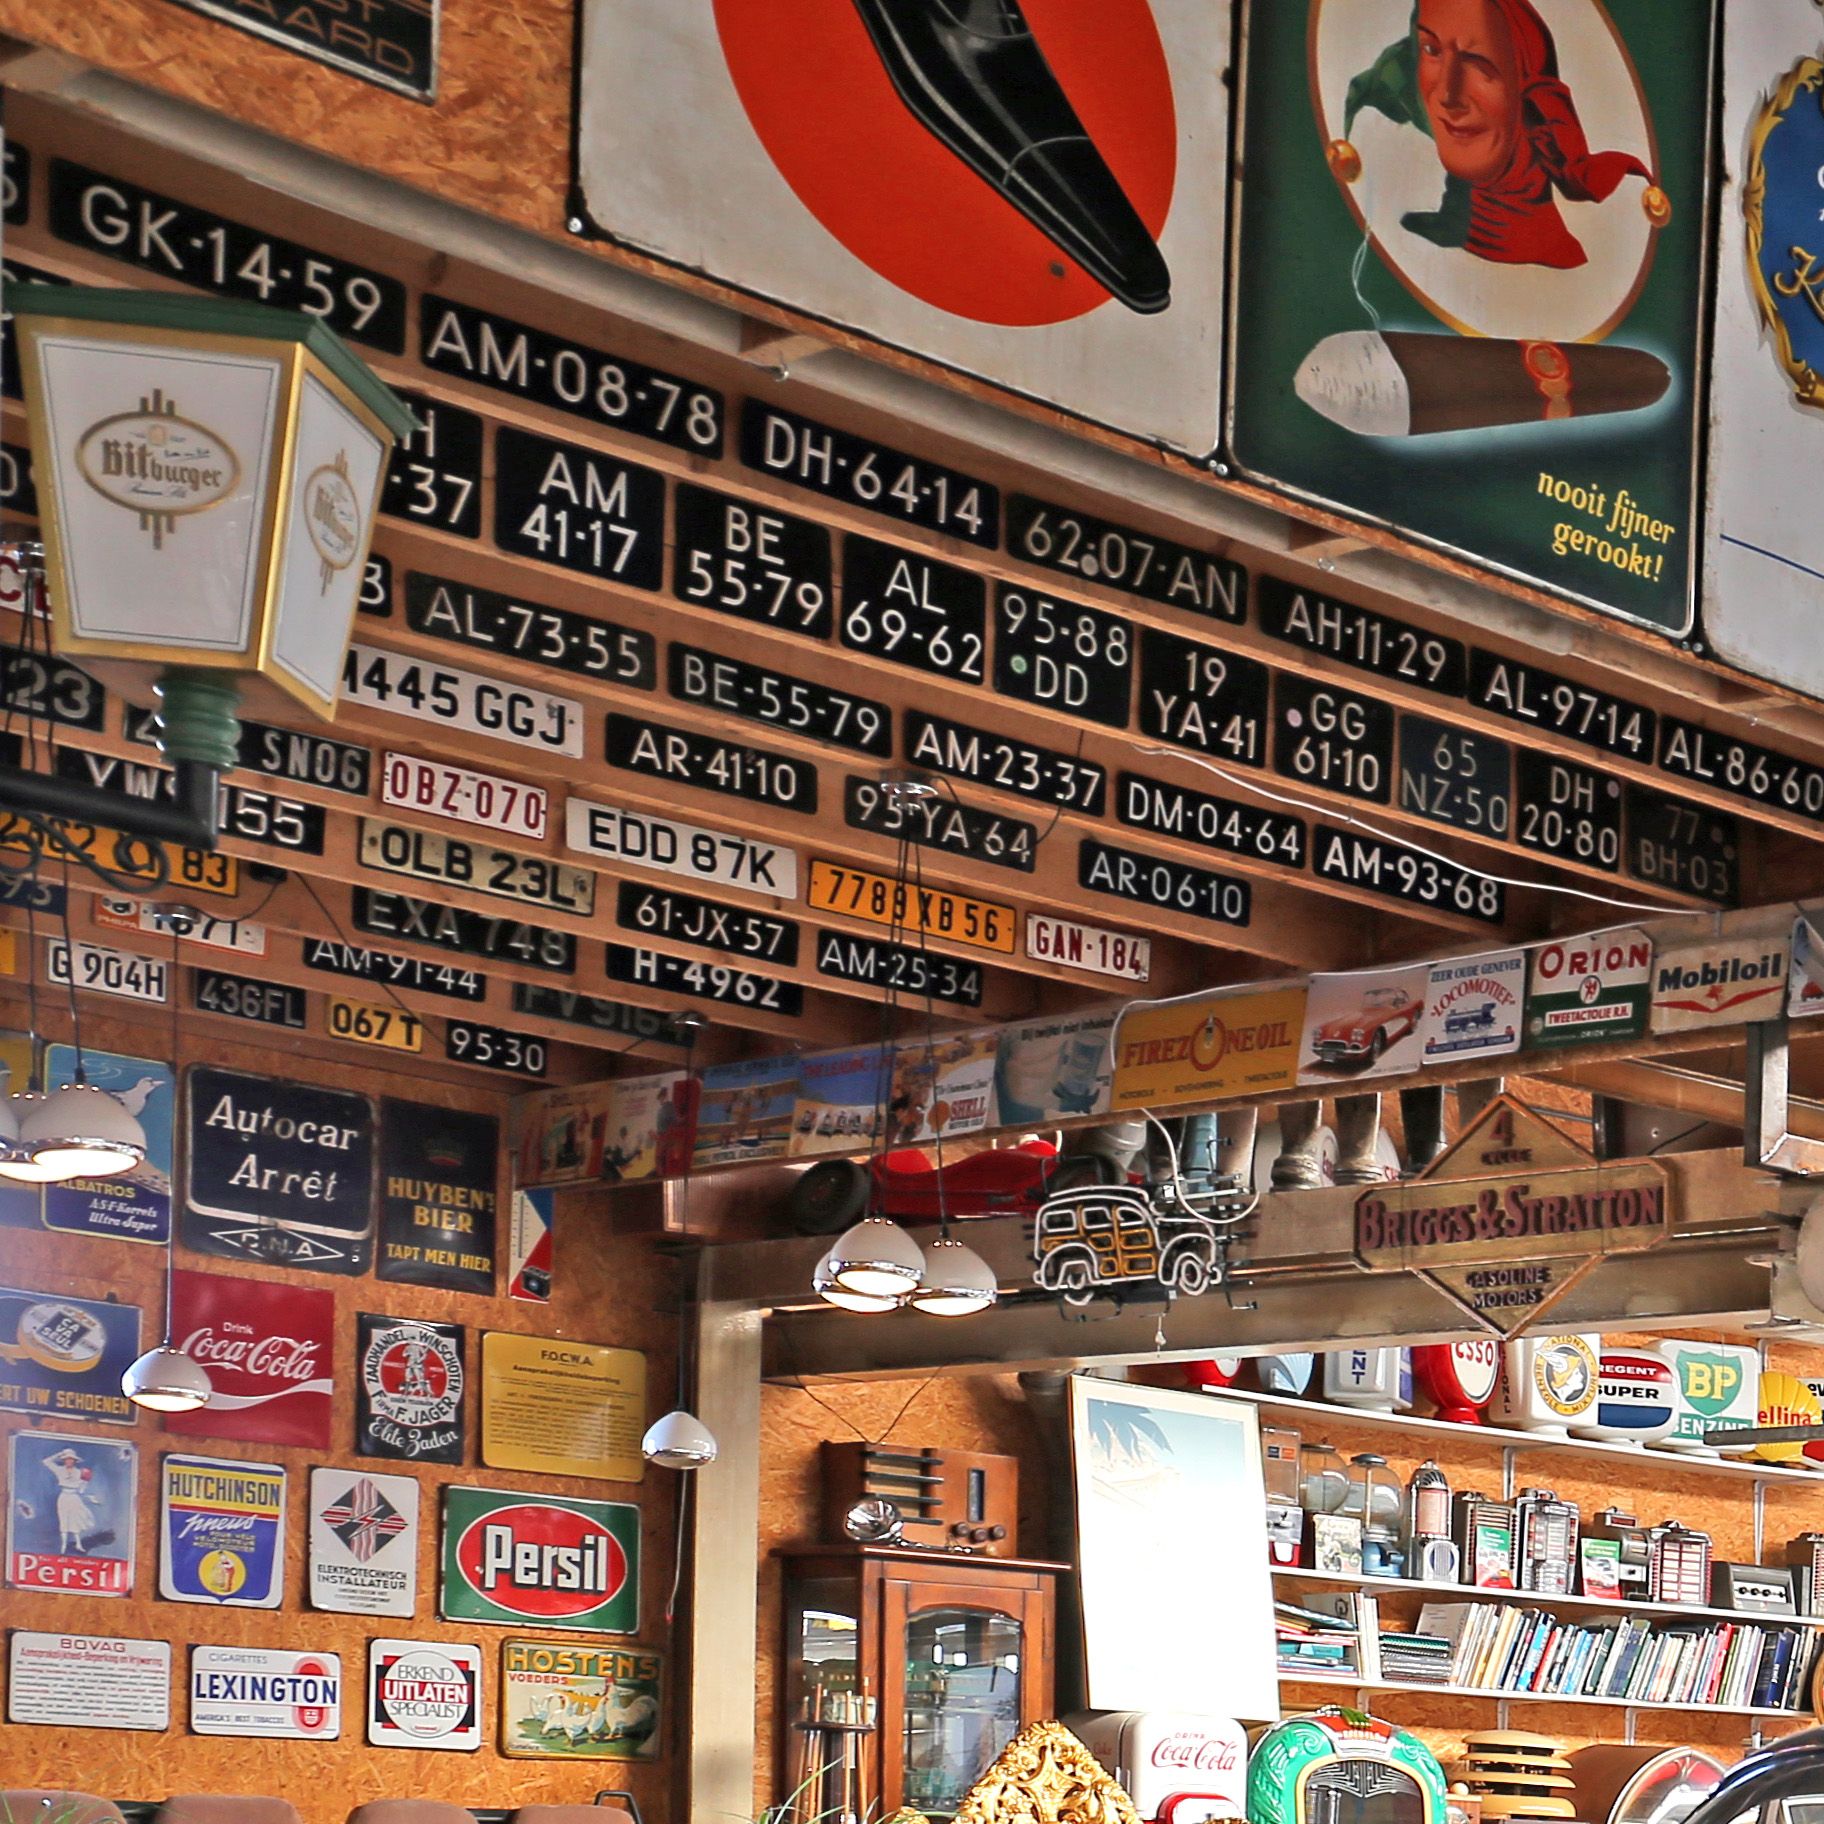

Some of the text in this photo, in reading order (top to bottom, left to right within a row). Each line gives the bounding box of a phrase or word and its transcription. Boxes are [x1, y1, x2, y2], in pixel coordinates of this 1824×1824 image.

[80, 184, 384, 332] GK-14-59
[427, 310, 718, 446] AM-08-78
[101, 439, 222, 492] Bitburger
[540, 452, 630, 520] AM
[764, 414, 983, 535] DH-64-14
[1538, 471, 1676, 548] nooit fijner
[520, 504, 640, 573] 41-17
[725, 506, 785, 566] BE
[1552, 516, 1664, 583] gerookt!
[687, 551, 824, 627] 55-79
[885, 559, 947, 613] AL
[424, 586, 642, 678] AL-73-55
[845, 601, 982, 677] 69-62
[1004, 595, 1130, 667] 95-88
[1286, 597, 1447, 682] AH-11-29
[684, 653, 880, 745] BE-55-79
[1034, 655, 1090, 707] DD
[1187, 653, 1227, 696] 19
[474, 685, 568, 746] GGJ
[1153, 689, 1257, 758] YA-41
[1310, 692, 1366, 740] GG
[1486, 666, 1643, 753] AL-97-14
[630, 729, 797, 801] AR-41-10
[914, 723, 1100, 807] AM-23-37
[1294, 739, 1380, 793] 61-10
[1433, 733, 1477, 777] 65
[1666, 728, 1824, 813] AL-86-60
[1551, 767, 1594, 814] DH
[1128, 783, 1300, 860] DM-04-64
[1523, 805, 1619, 864] 20-80
[380, 826, 578, 906] OLB 23L
[587, 809, 777, 889] EDD 87K
[1089, 851, 1244, 920] AR-06-10
[1323, 837, 1499, 916] AM-93-68
[368, 895, 459, 944] EXA
[636, 894, 784, 956] 61-JX-57
[964, 906, 999, 944] 56
[821, 939, 980, 1001] AM-25-34
[1036, 921, 1143, 979] GAN-184
[1538, 943, 1650, 980] ORION
[1658, 954, 1782, 992] Mobiloil
[84, 952, 165, 998] 904H
[331, 1002, 420, 1048] 067 T
[1258, 1021, 1292, 1049] OIL
[451, 1028, 545, 1074] 95-30
[205, 1095, 359, 1150] Autocar
[229, 1153, 338, 1202] Arrêt
[413, 1205, 474, 1234] BIER
[386, 1243, 491, 1272] TAPT MEN HIER
[1465, 1265, 1553, 1288] GASOLINE
[1471, 1287, 1540, 1311] MOTORS
[223, 1321, 254, 1335] Drink
[180, 1327, 322, 1381] Coca-Cola
[1599, 1363, 1657, 1377] REGENT
[56, 1390, 130, 1414] SCHOENEN
[1686, 1361, 1738, 1401] BP
[409, 1396, 456, 1425] JAGER
[368, 1416, 459, 1457] Elite Zaden
[168, 1472, 281, 1507] HUTCHINSON
[178, 1513, 257, 1540] pneus
[18, 1554, 122, 1589] Persil
[317, 1563, 407, 1581] ELEKTROTECHNISCH
[317, 1574, 407, 1591] INSTALLATEUR
[484, 1524, 608, 1593] Persil
[60, 1638, 126, 1653] BOVAG
[209, 1653, 268, 1665] CIGARETTES
[508, 1647, 660, 1679] HOSTENS
[195, 1673, 337, 1705] LEXINGTON
[383, 1682, 469, 1703] UITLATEN
[397, 1664, 455, 1681] ERKEND
[508, 1673, 569, 1686] VOEDERS
[389, 1701, 464, 1720] SPECIALIST
[1150, 1737, 1239, 1773] Coca-Cola
